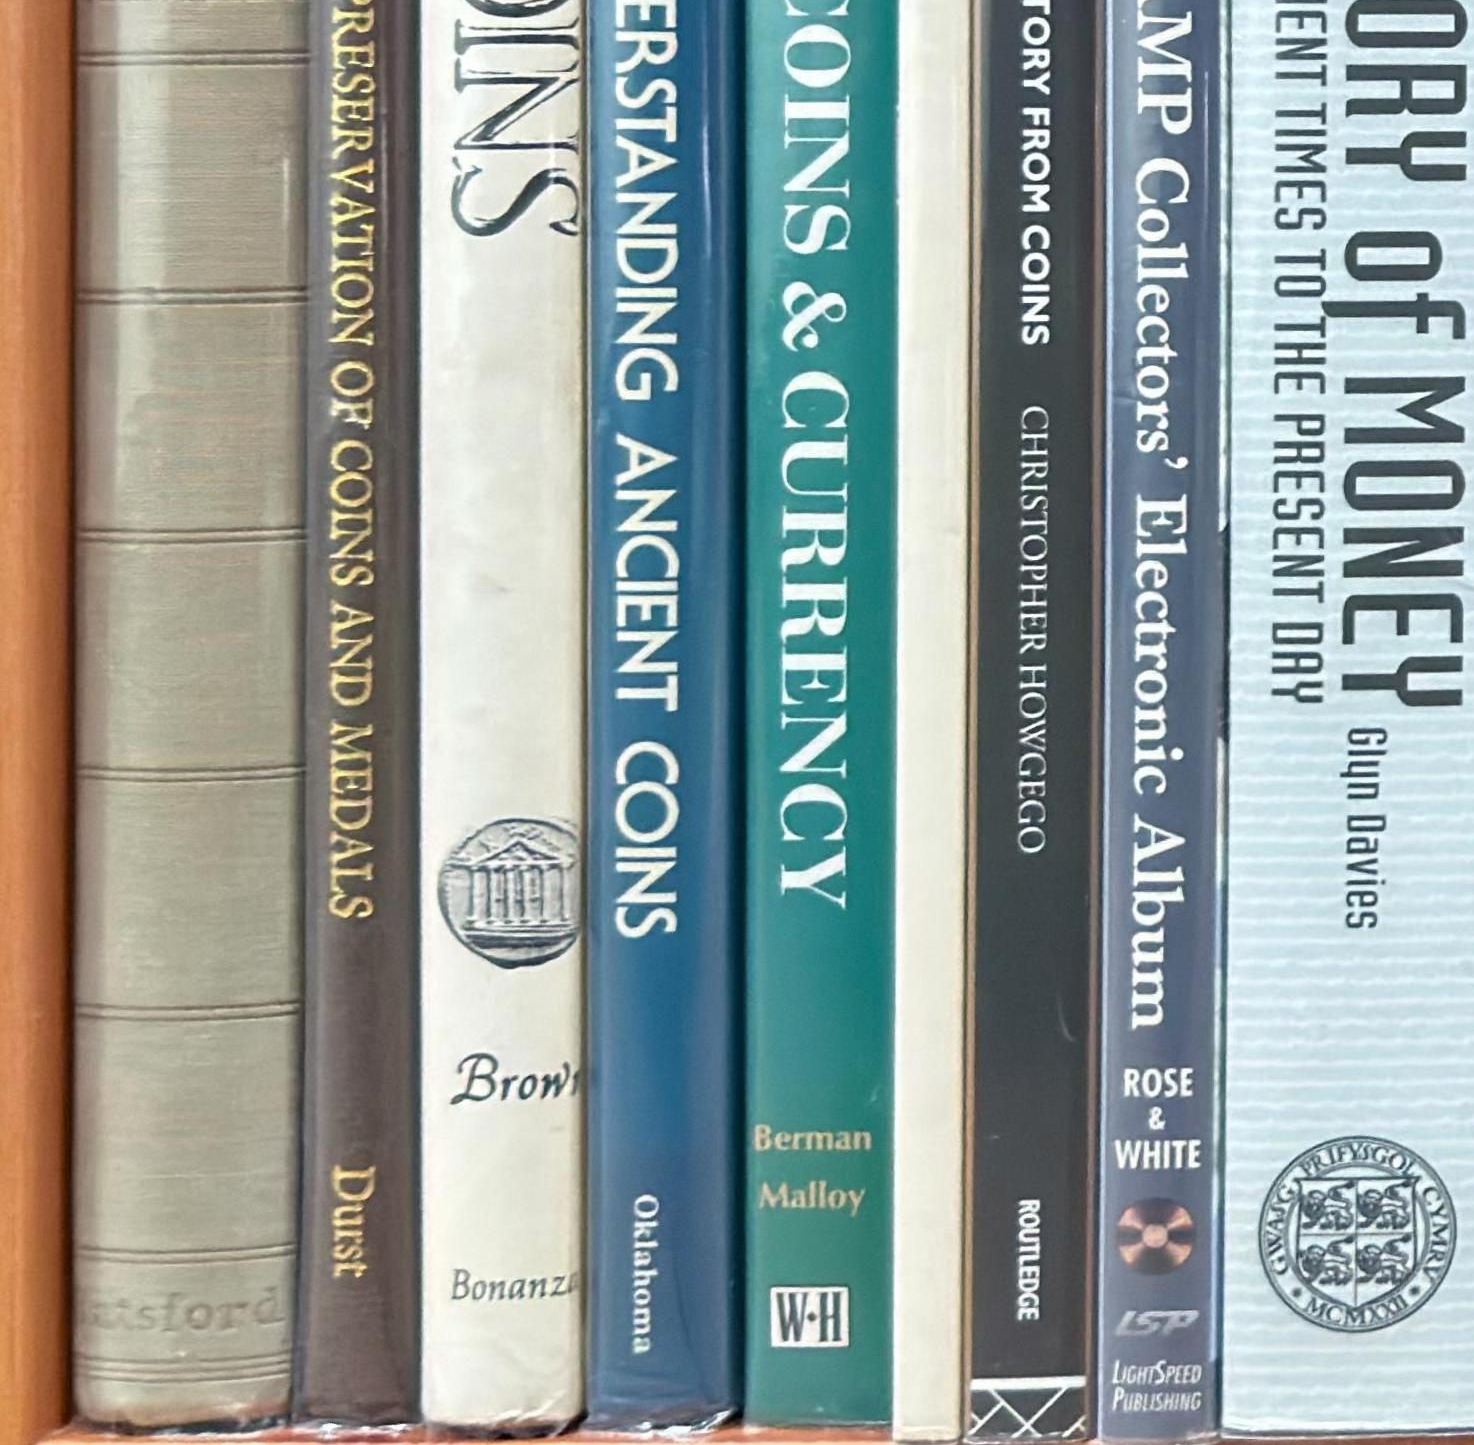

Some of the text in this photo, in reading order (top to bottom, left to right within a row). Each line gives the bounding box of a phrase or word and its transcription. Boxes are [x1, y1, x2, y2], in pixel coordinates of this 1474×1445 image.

[1021, 107, 1050, 213] FROM
[1273, 109, 1327, 231] TIMES
[782, 280, 848, 352] &
[1020, 223, 1050, 346] COINS
[1273, 248, 1327, 299] TO
[329, 361, 374, 430] OF
[1272, 316, 1327, 396] THE
[329, 439, 374, 588] COINS
[1019, 405, 1050, 655] CHRISTOPHER
[1272, 413, 1327, 605] PRESENT
[1341, 377, 1466, 707] MONEY
[614, 433, 679, 712] ANCIENT
[329, 600, 374, 708] AND
[780, 371, 850, 909] CURRENCY
[1133, 493, 1189, 796] Electronic
[1270, 621, 1325, 705] DAY
[1017, 663, 1048, 854] HOWGEGO
[327, 724, 375, 920] MEDALS
[614, 741, 680, 938] COINS
[1339, 728, 1388, 930] Glyn Davies
[1130, 814, 1186, 1030] Album
[753, 1124, 872, 1152] Berman
[1123, 1067, 1194, 1098] ROSE
[1148, 1105, 1166, 1131] &
[759, 1181, 865, 1217] Malloy
[1114, 1139, 1202, 1170] WHITE
[1266, 1184, 1296, 1276] GWASG
[1300, 1142, 1416, 1177] PRIFYSGOL
[332, 1165, 376, 1278] Durst
[631, 1193, 660, 1354] Oklahoma
[1016, 1199, 1040, 1321] ROUTLEDGE
